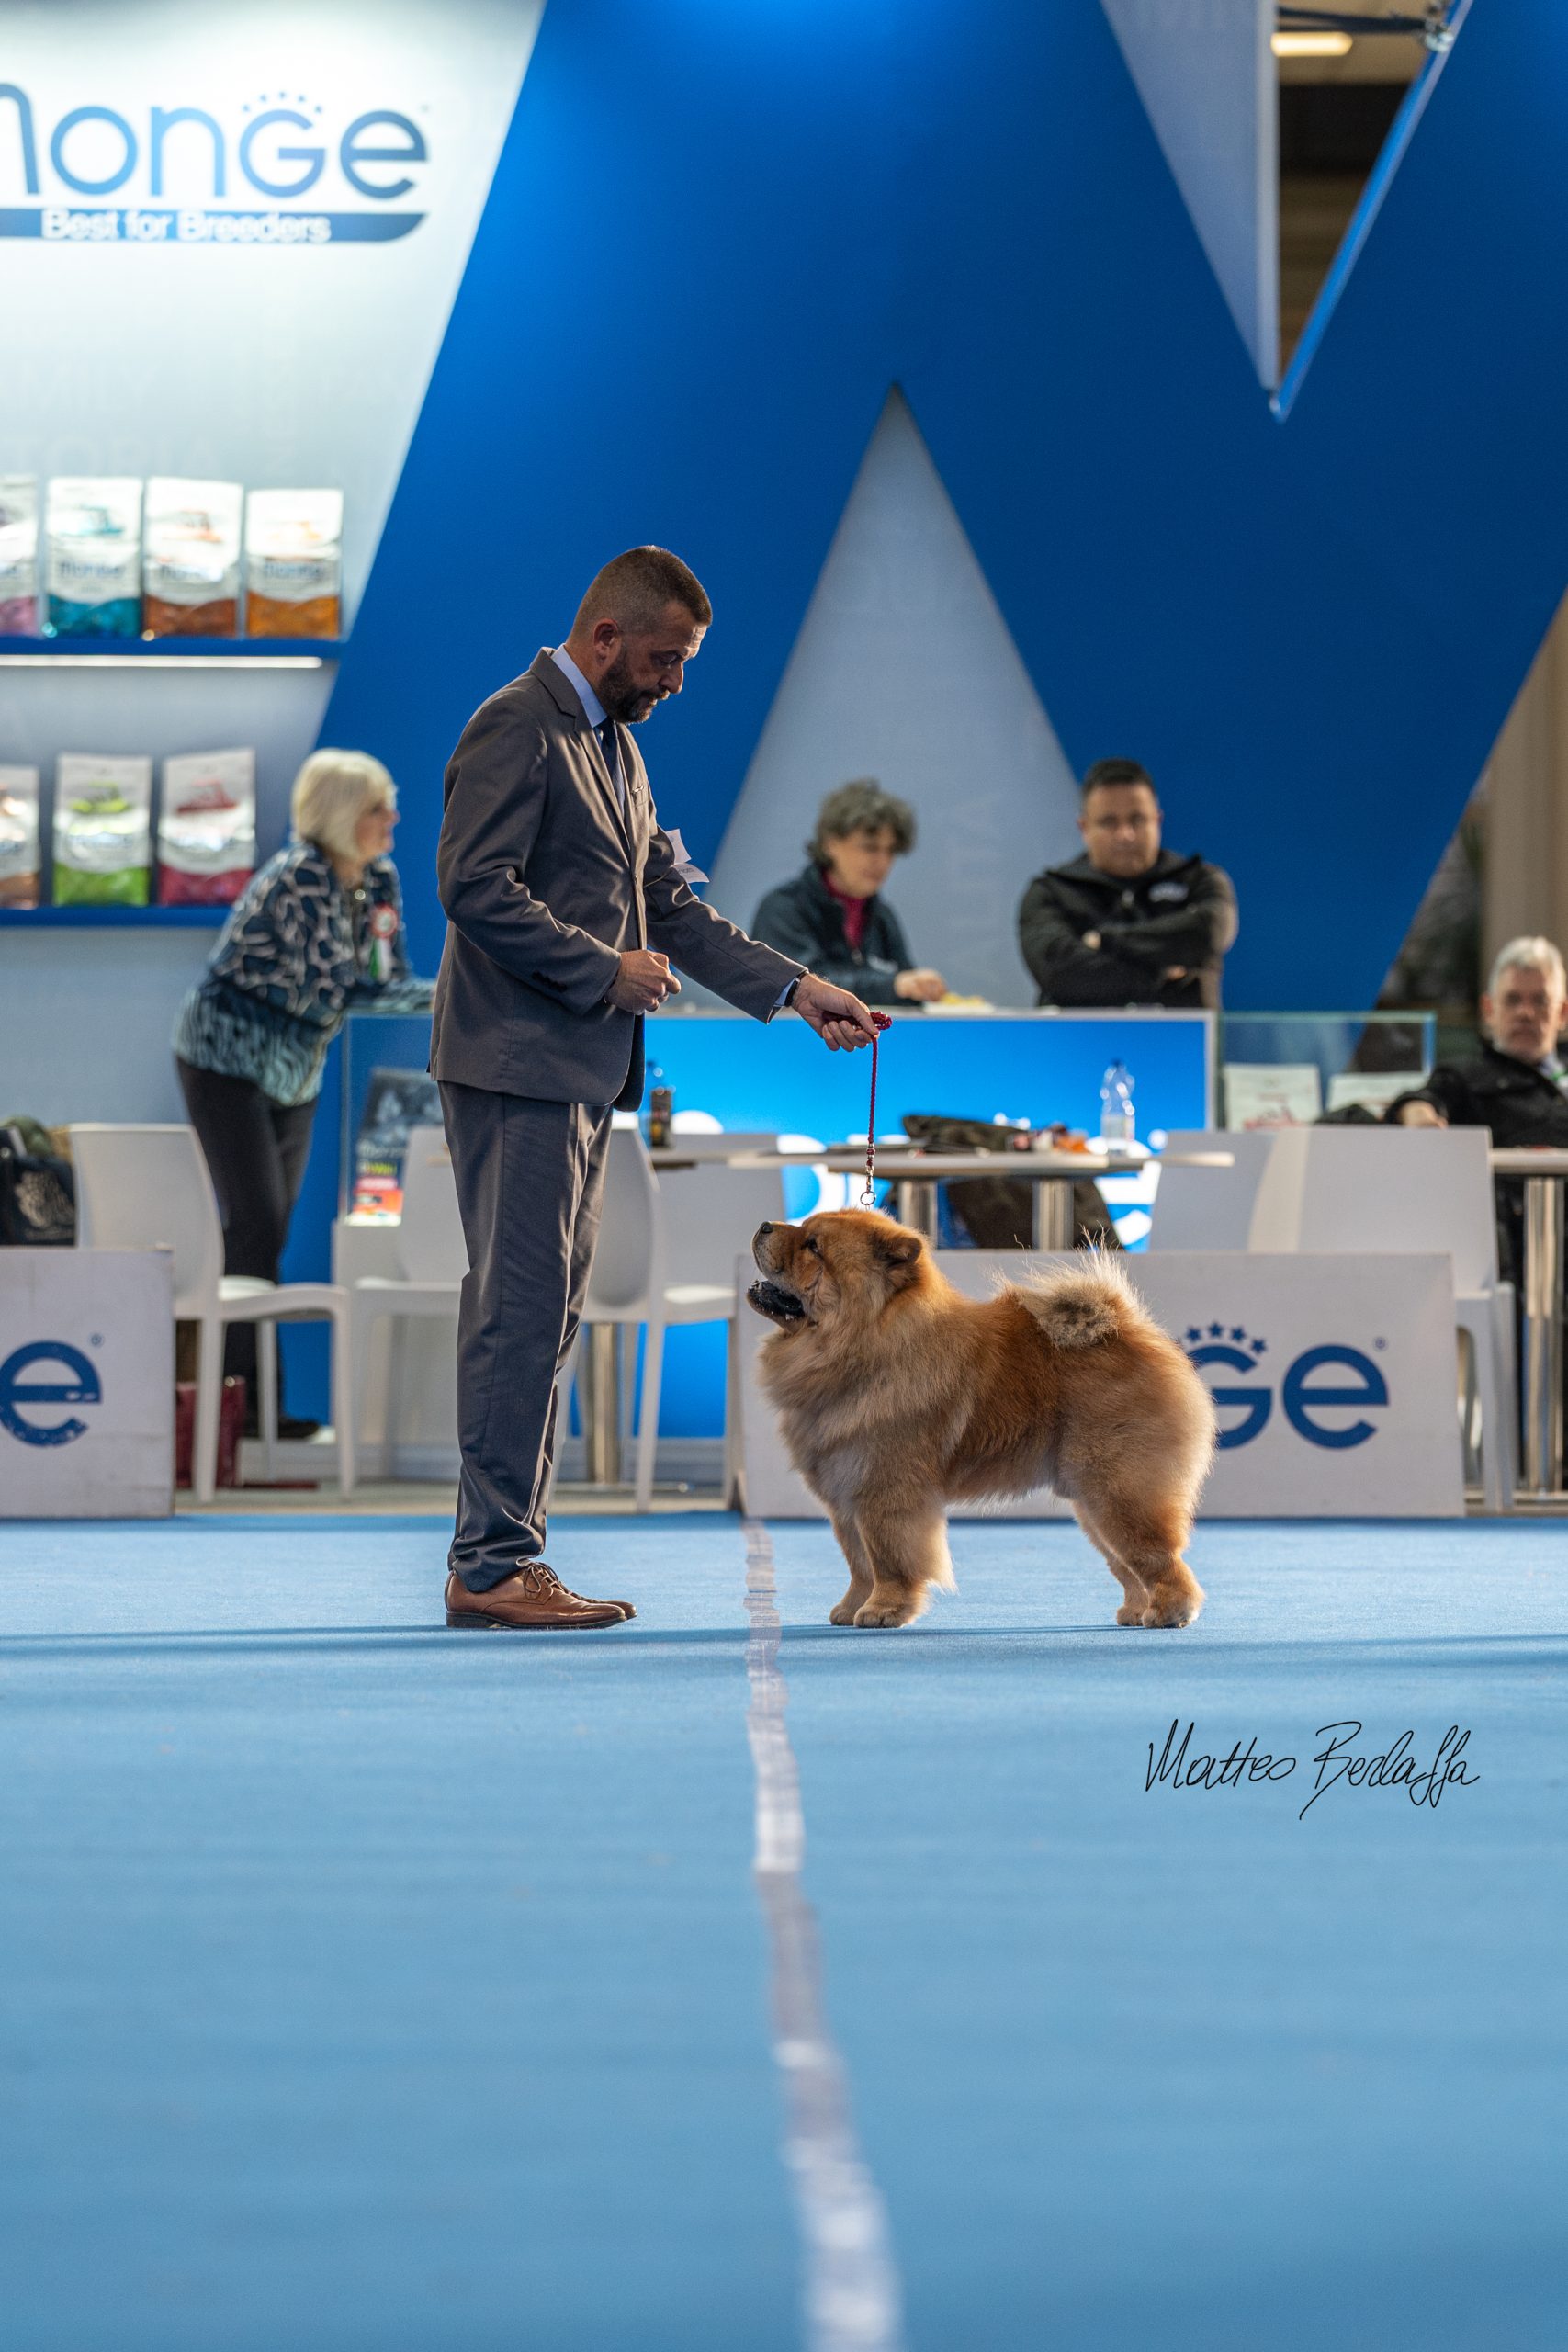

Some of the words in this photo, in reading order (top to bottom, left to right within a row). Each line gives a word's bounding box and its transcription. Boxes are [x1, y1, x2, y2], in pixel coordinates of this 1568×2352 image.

[42, 208, 120, 241] Best
[124, 209, 174, 241] for
[177, 208, 332, 243] Breeders
